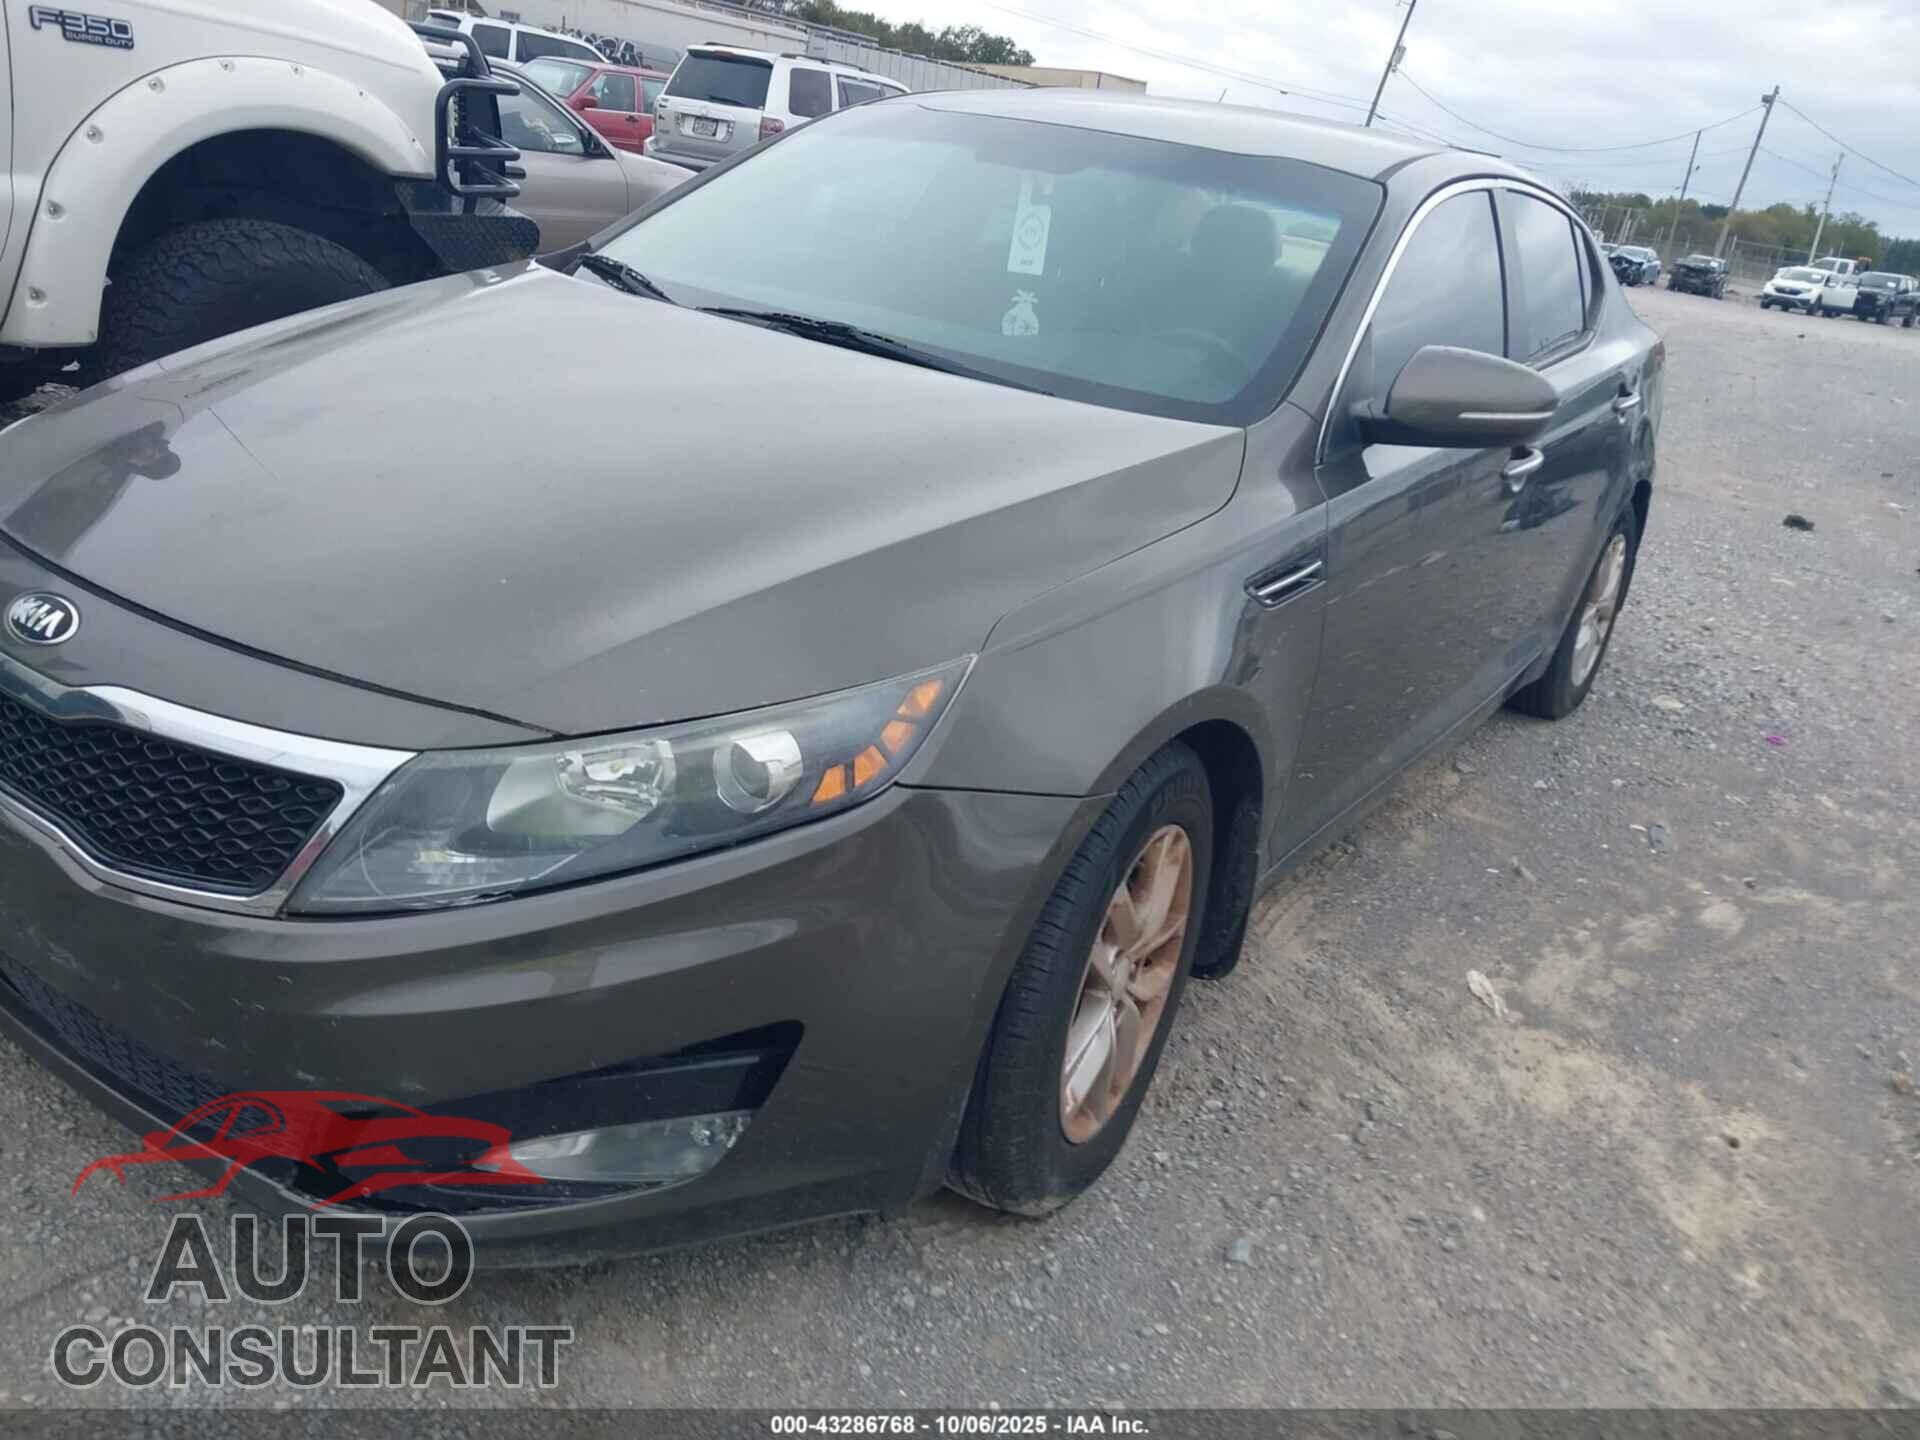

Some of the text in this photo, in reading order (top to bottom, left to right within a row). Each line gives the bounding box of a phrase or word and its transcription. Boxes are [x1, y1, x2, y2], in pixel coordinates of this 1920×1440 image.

[64, 31, 133, 48] SUPER DUTY
[11, 598, 65, 638] KIA
